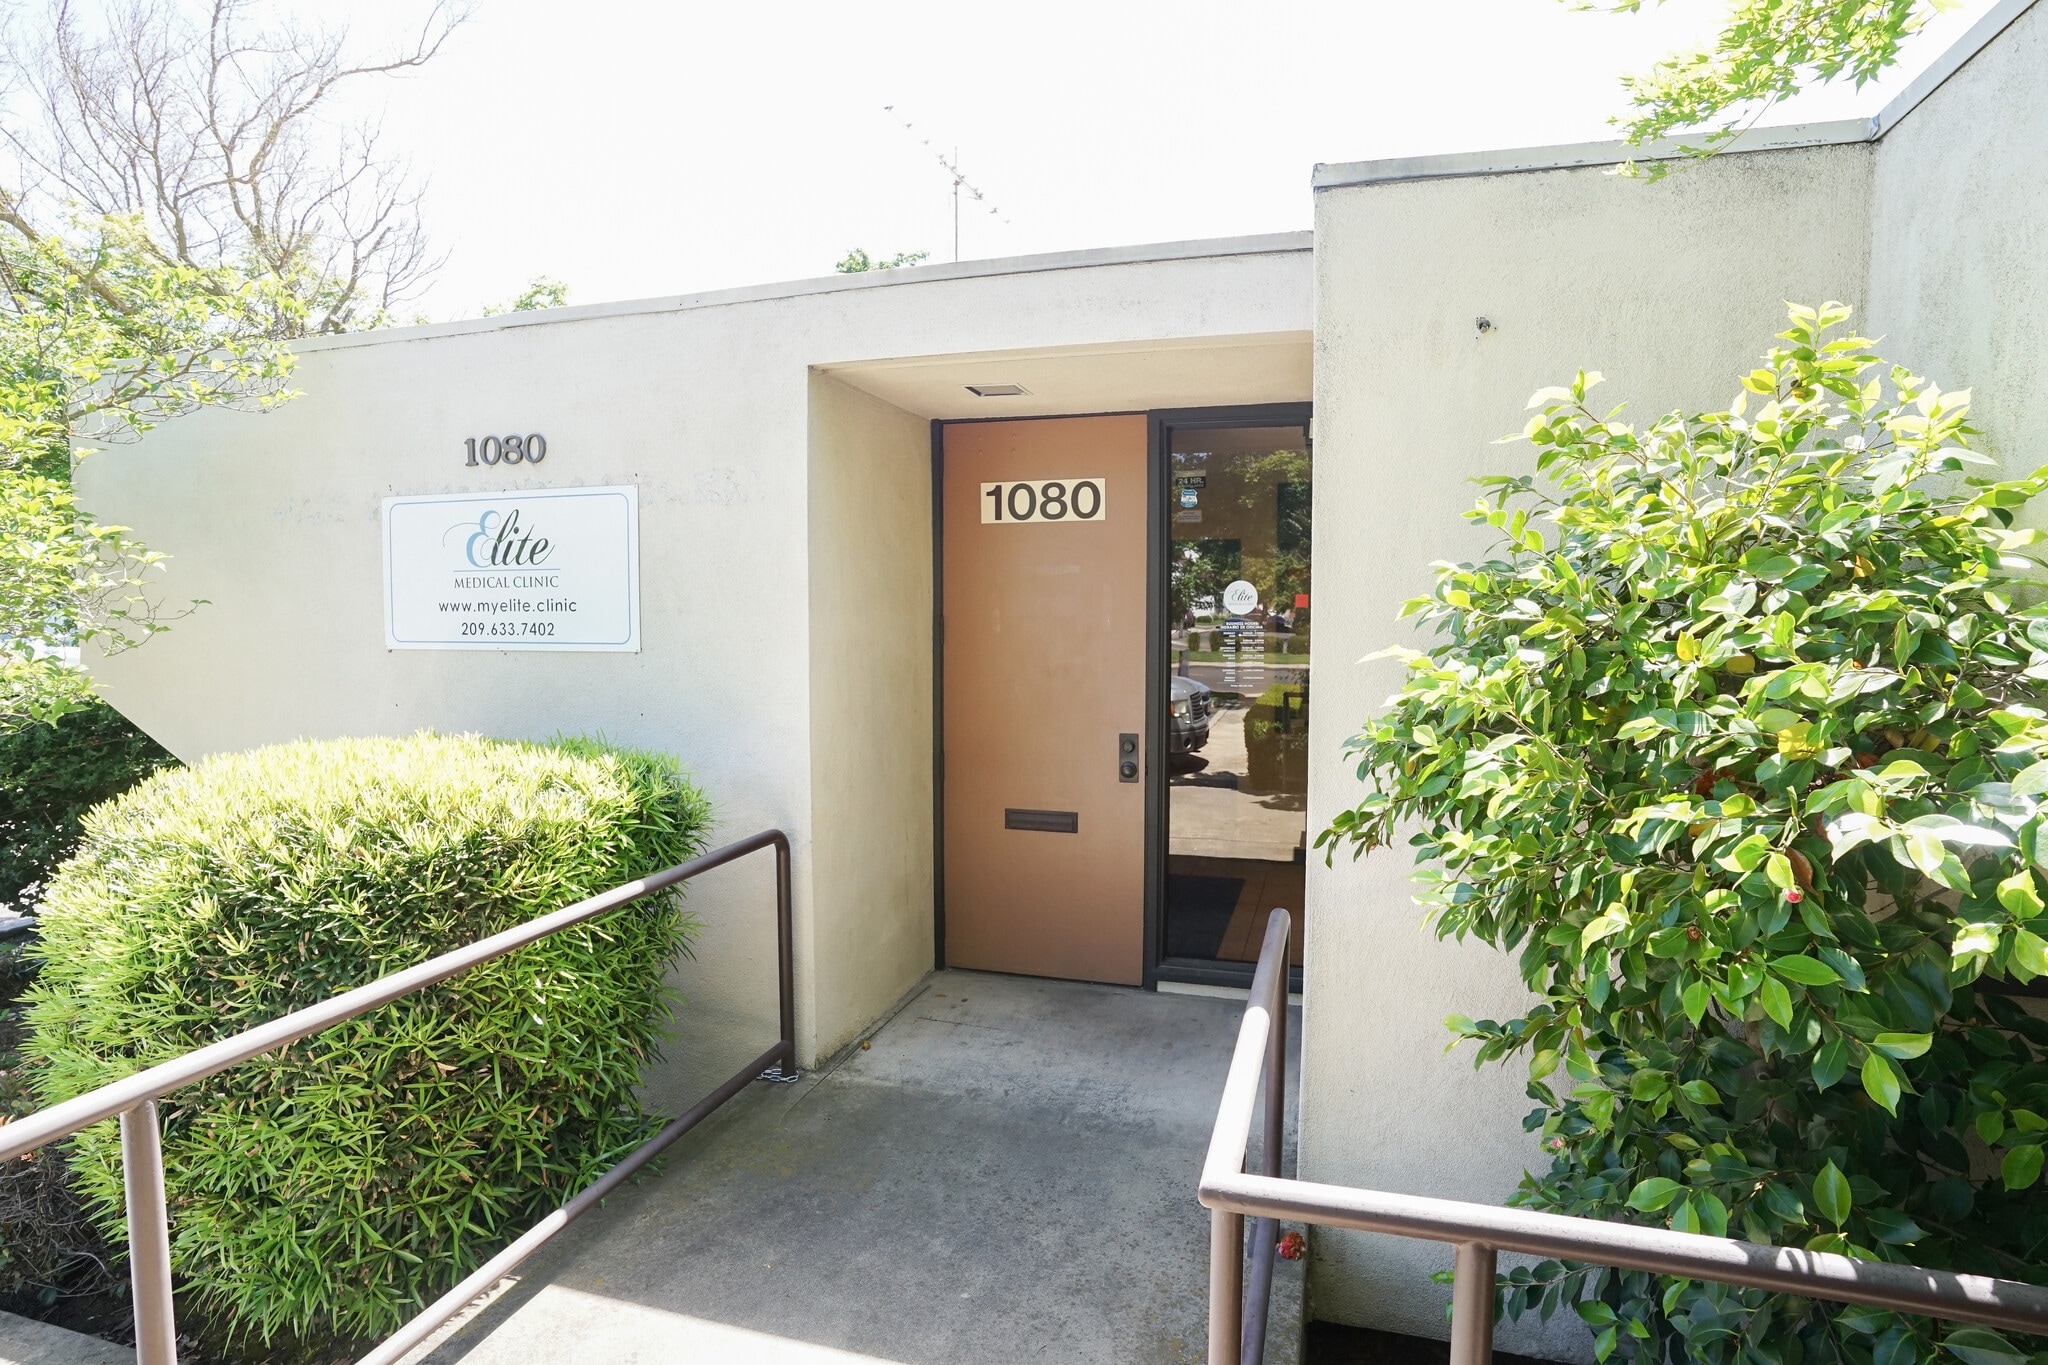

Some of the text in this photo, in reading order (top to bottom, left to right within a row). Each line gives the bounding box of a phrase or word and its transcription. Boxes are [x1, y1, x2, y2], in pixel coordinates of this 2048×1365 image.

[464, 433, 547, 467] 1080
[986, 480, 1101, 521] 1080
[443, 509, 556, 568] Elite
[454, 575, 559, 589] MEDICAL CLINIC
[438, 598, 577, 615] www.myelite.clinic
[461, 622, 555, 636] 209.633.7402
